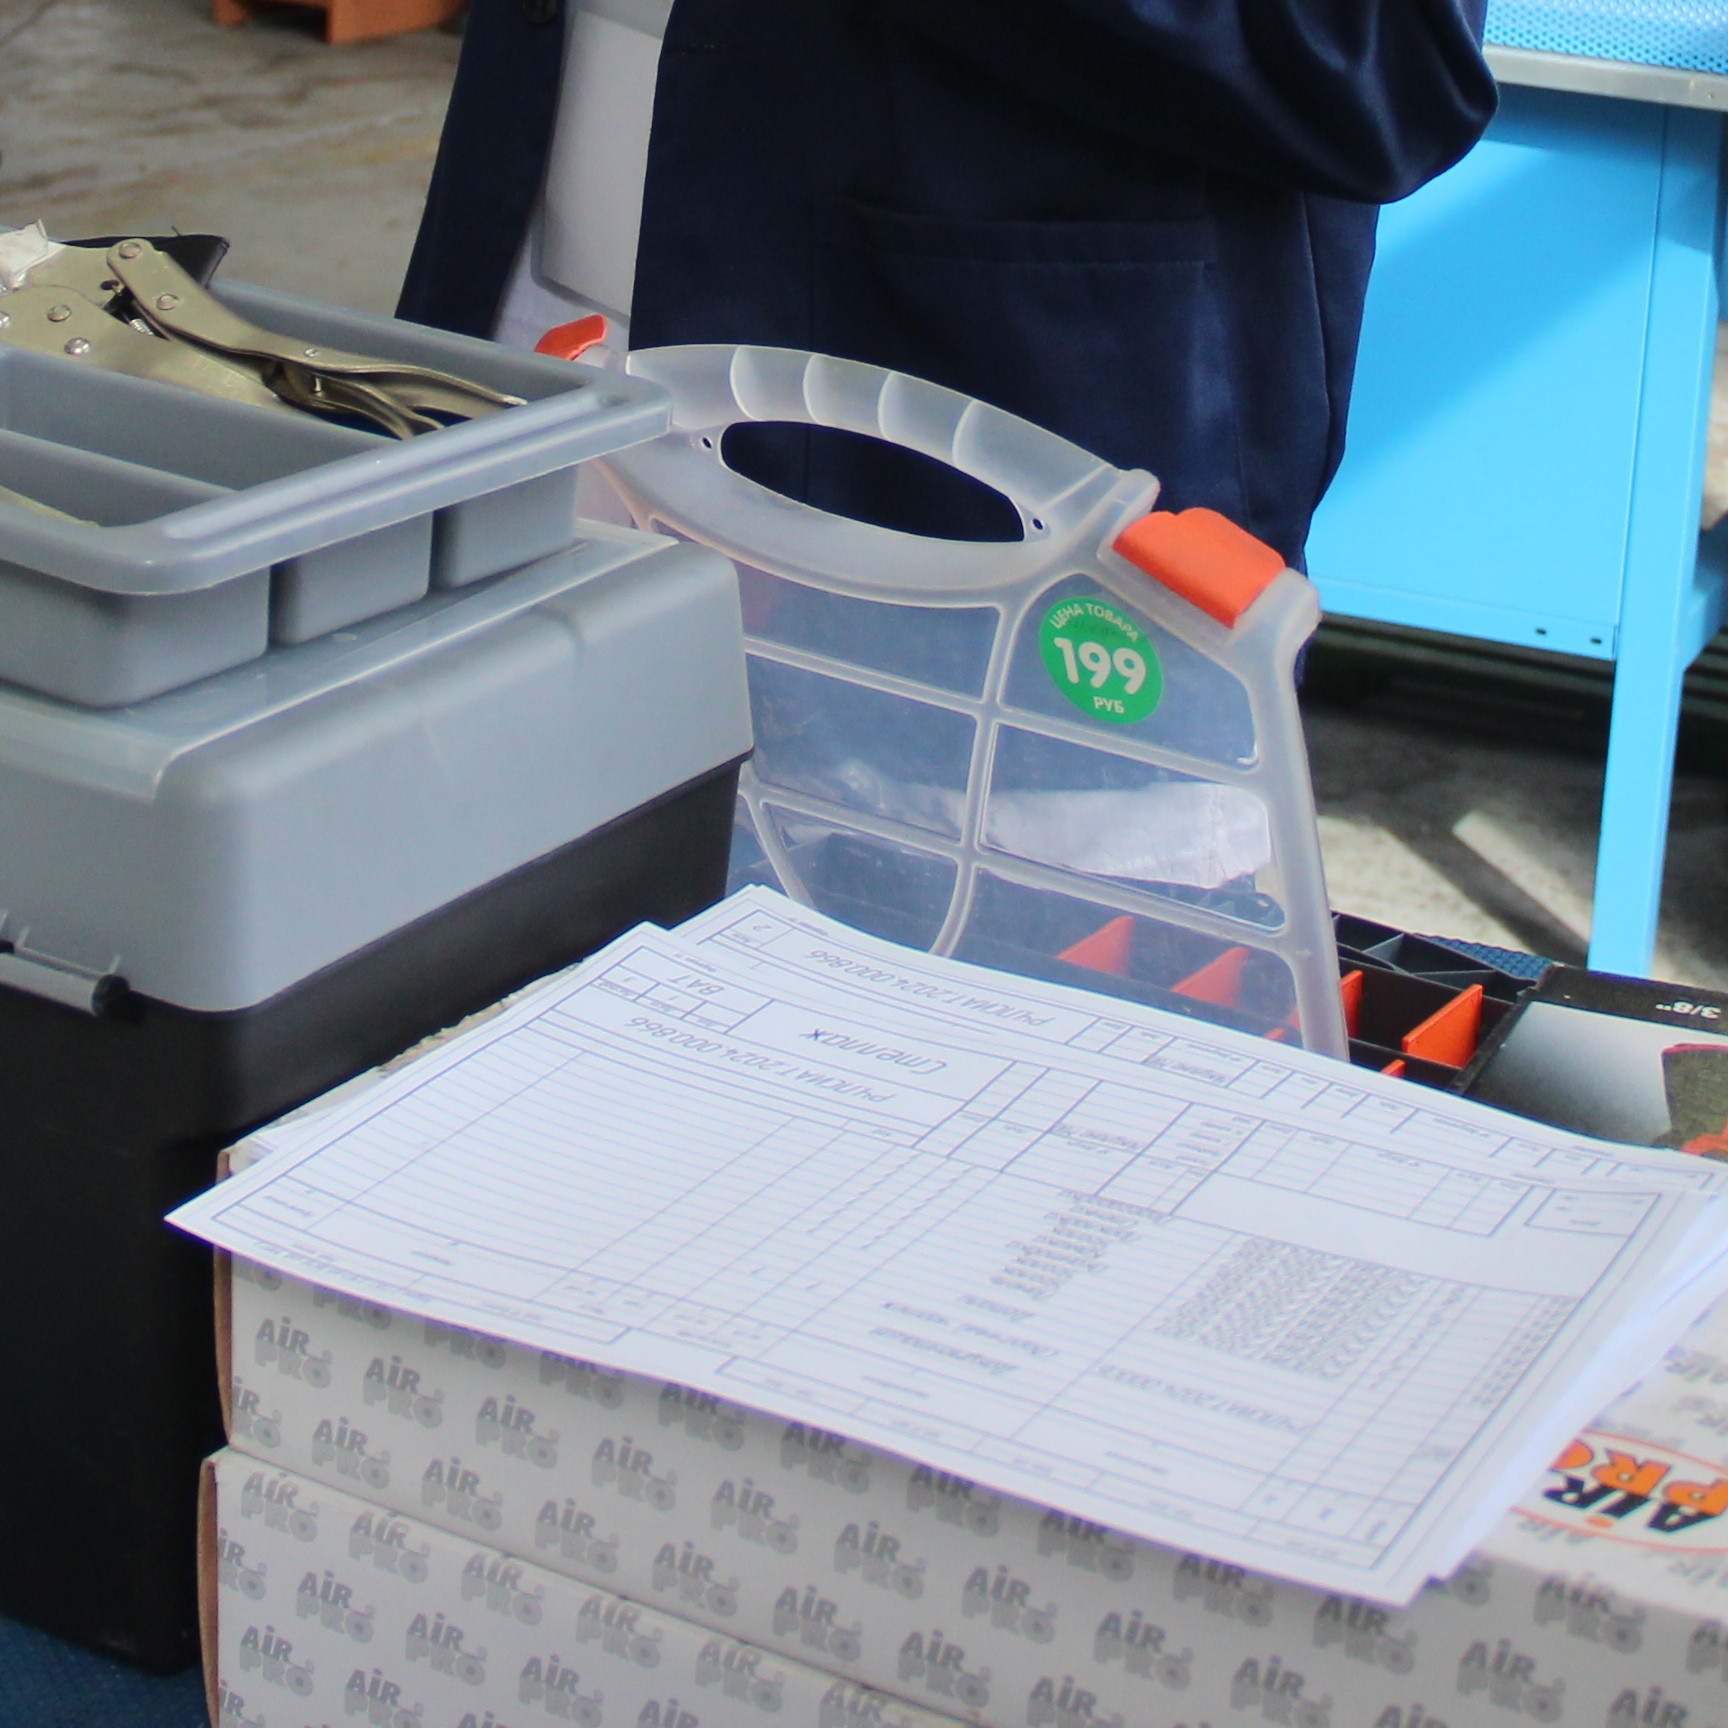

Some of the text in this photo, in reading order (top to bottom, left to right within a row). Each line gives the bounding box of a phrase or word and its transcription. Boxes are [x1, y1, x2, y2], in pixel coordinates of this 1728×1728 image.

[1050, 603, 1139, 642] ЦЕНА ТОВАРА
[1054, 637, 1146, 695] 199
[1093, 696, 1125, 714] РУБ
[1655, 1000, 1719, 1020] 3/8"
[799, 1027, 948, 1074] Стеллаж
